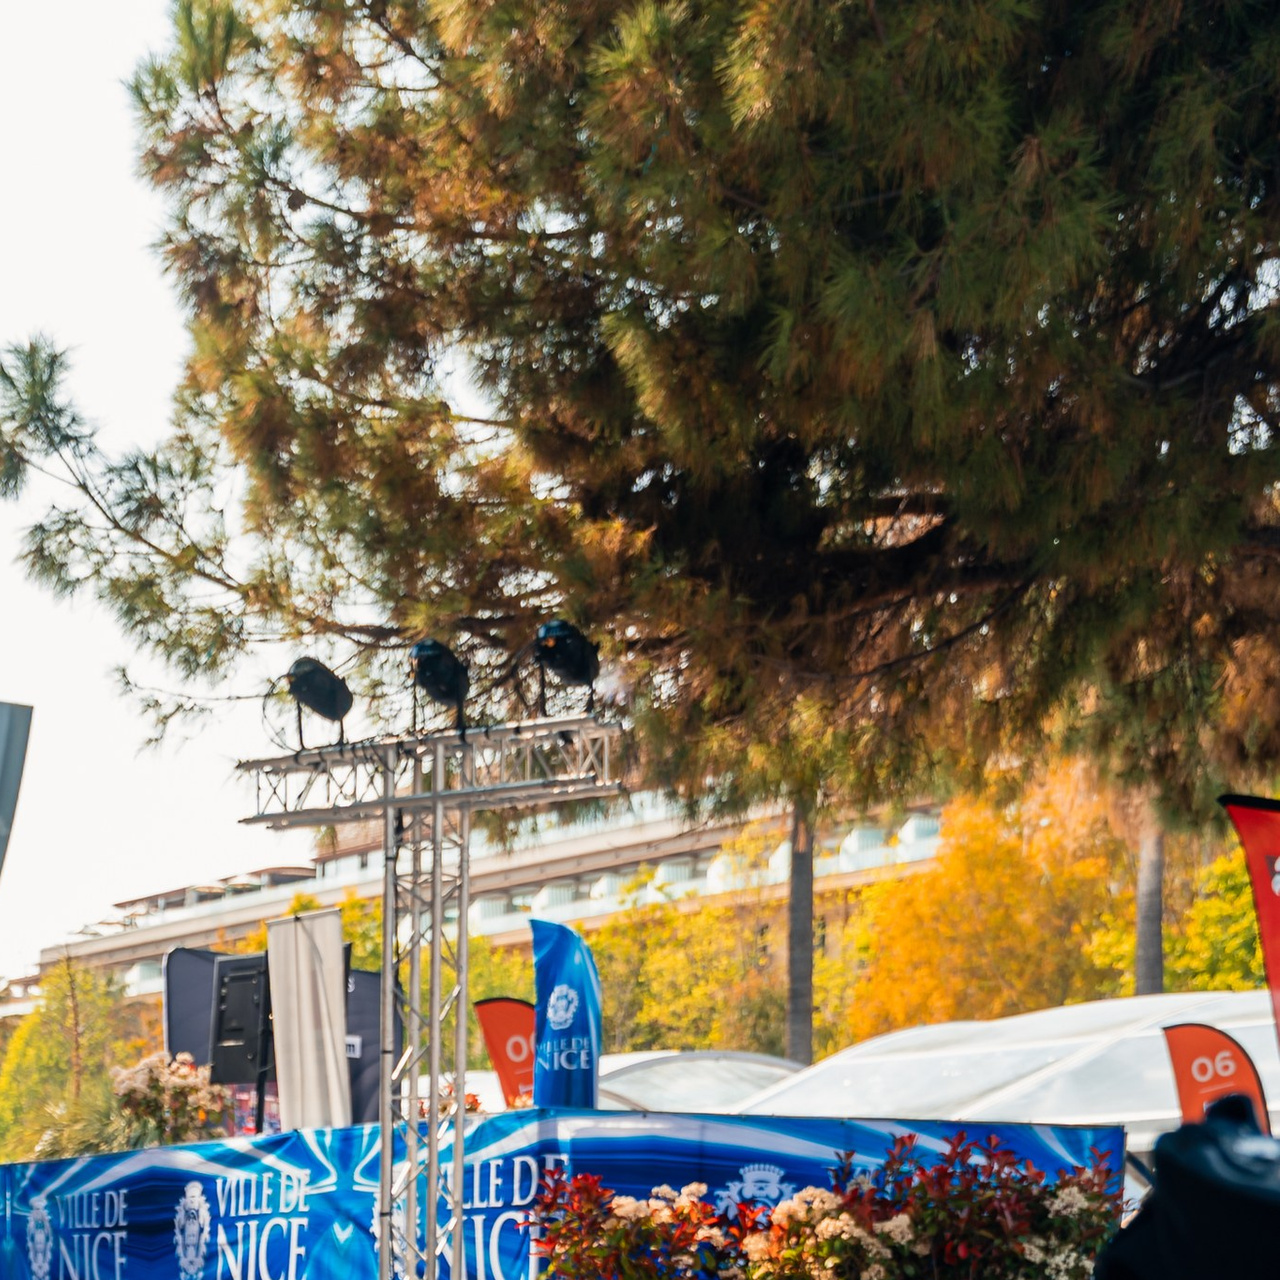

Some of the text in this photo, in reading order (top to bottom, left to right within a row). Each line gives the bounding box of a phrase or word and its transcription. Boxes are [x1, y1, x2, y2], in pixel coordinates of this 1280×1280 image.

[505, 1033, 536, 1063] 0
[571, 1037, 590, 1049] DE
[537, 1049, 590, 1070] NICE
[1191, 1050, 1237, 1083] 06
[216, 1168, 311, 1218] VILLE DE
[55, 1189, 129, 1229] VILLE DE
